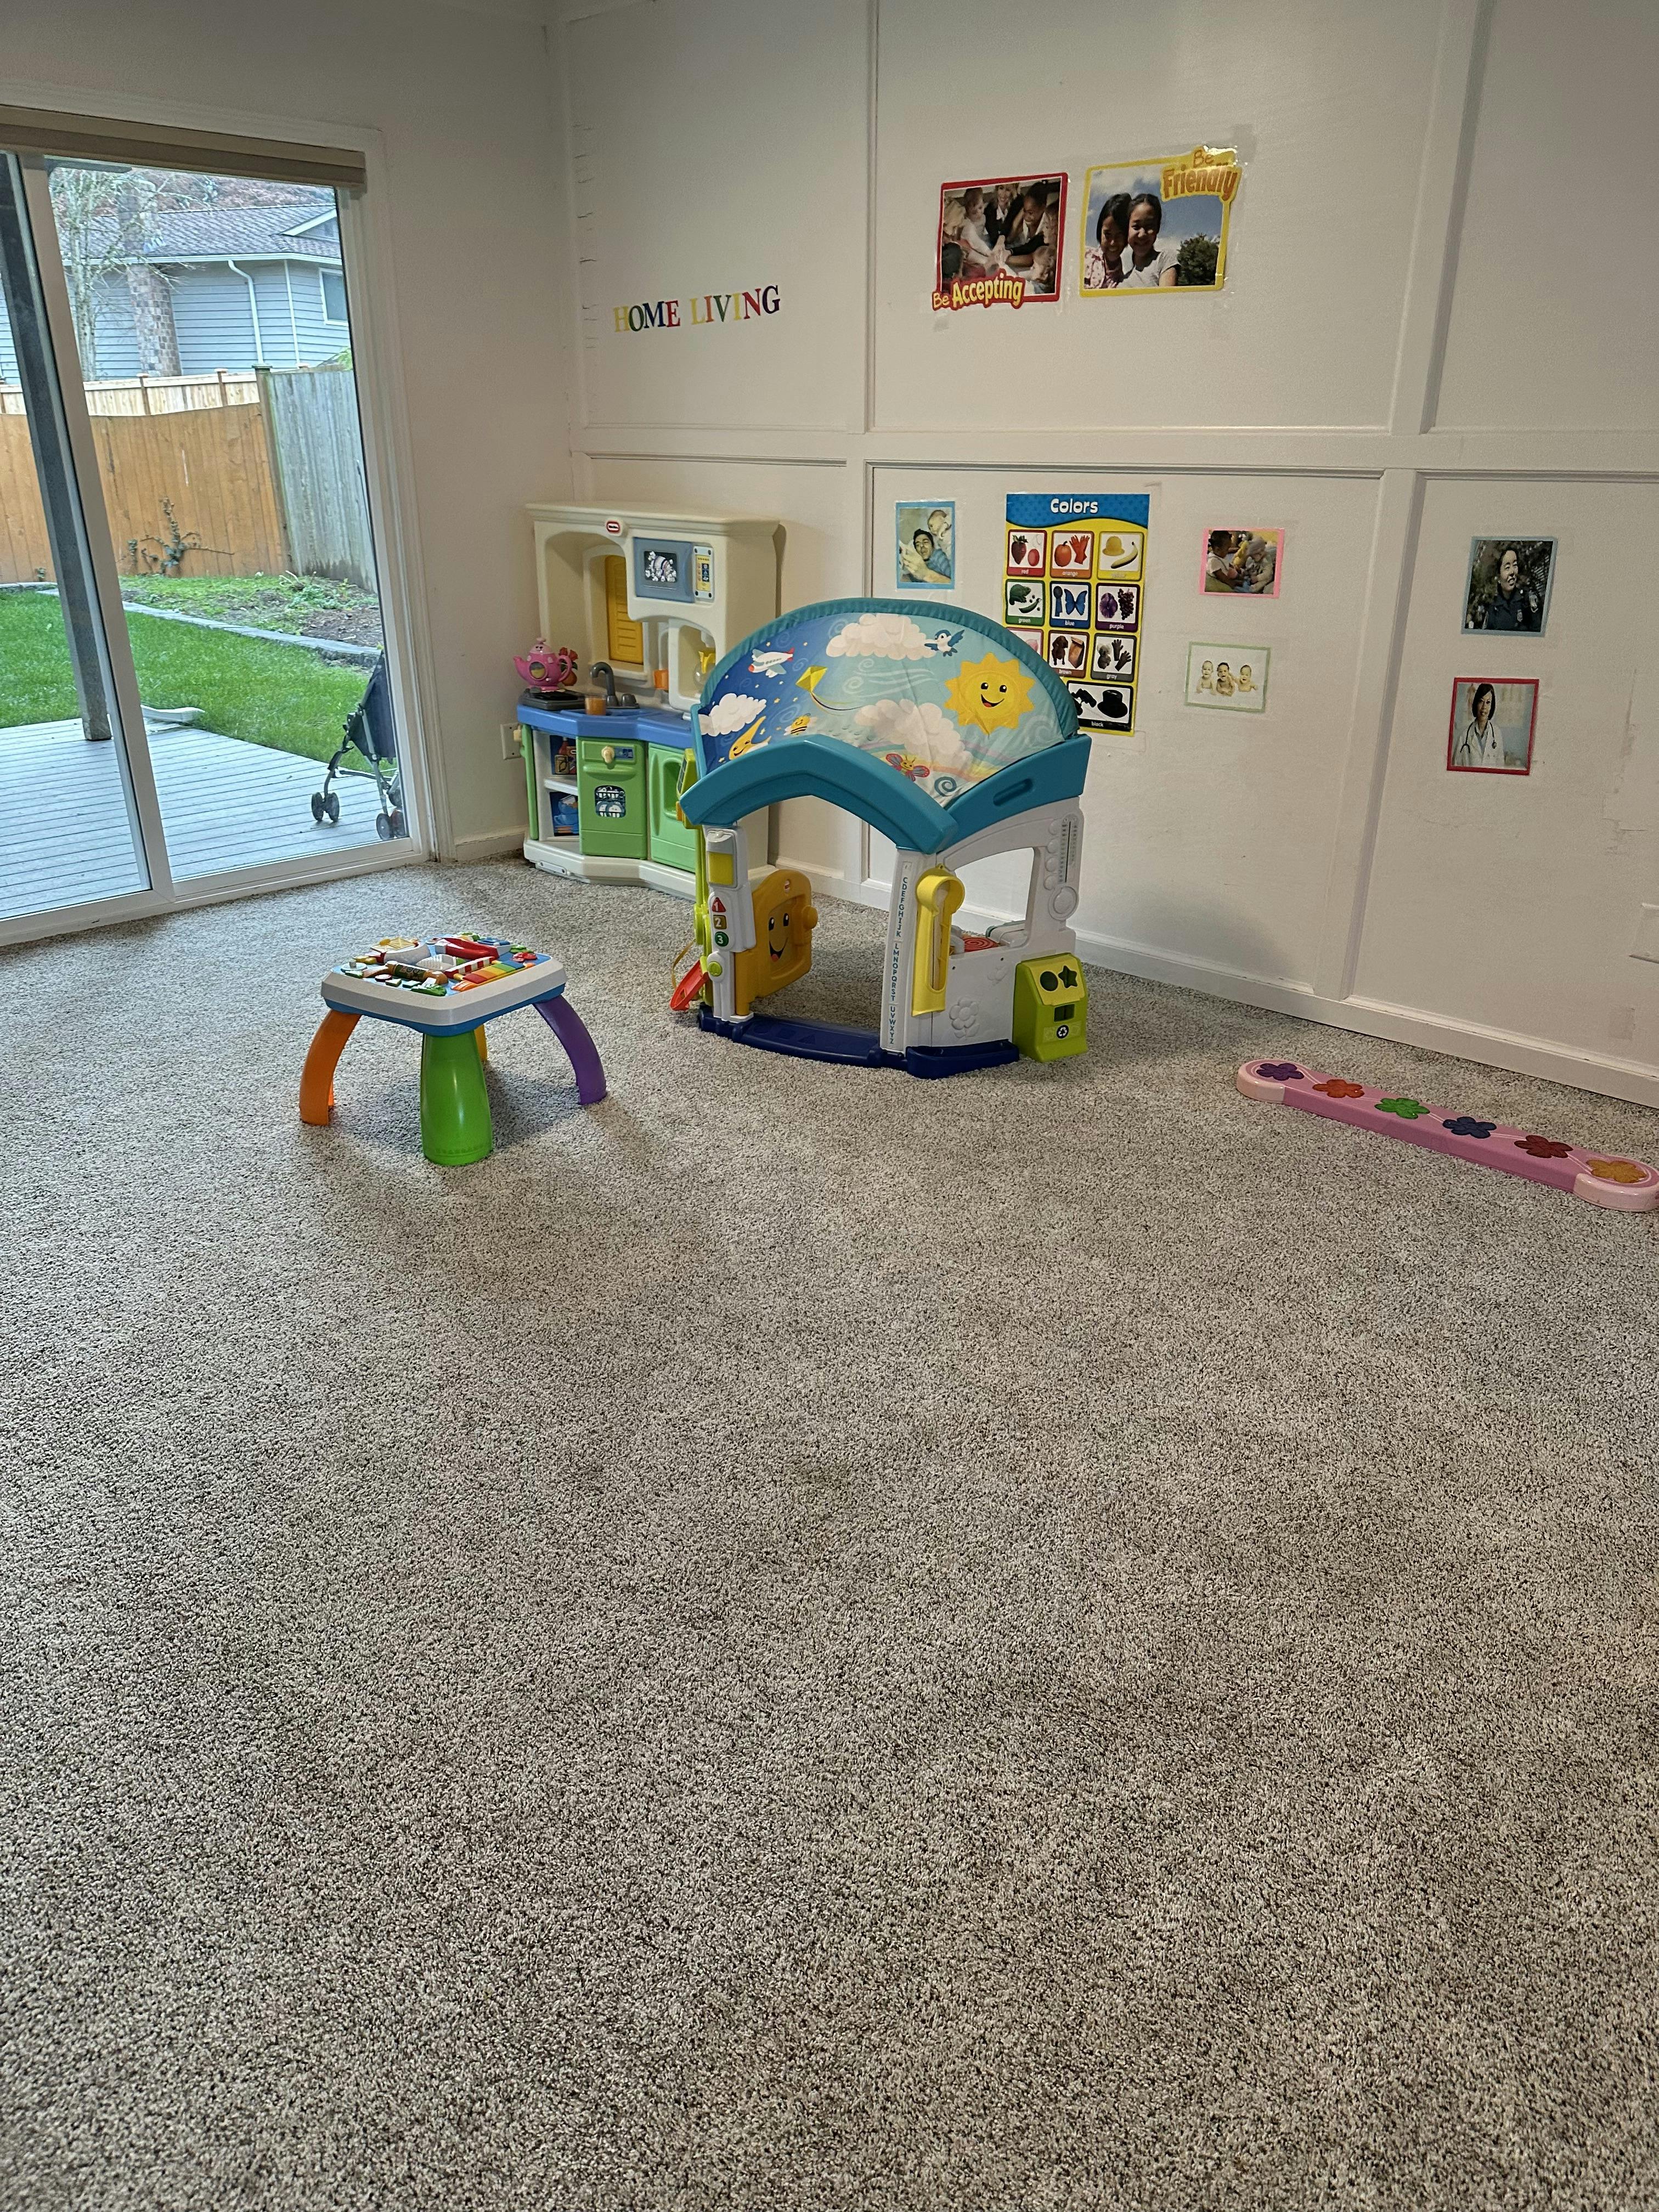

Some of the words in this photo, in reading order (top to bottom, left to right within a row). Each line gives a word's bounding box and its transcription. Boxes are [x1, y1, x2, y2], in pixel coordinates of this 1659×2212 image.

[1193, 150, 1214, 168] Be
[1163, 163, 1238, 201] Friendly
[934, 292, 950, 308] Be
[952, 273, 1023, 308] Accepting
[613, 300, 680, 332] HOME
[690, 285, 781, 325] LIVING
[1051, 498, 1098, 514] Colors
[713, 901, 719, 912] 1
[715, 917, 722, 927] 2
[717, 935, 724, 944] 3
